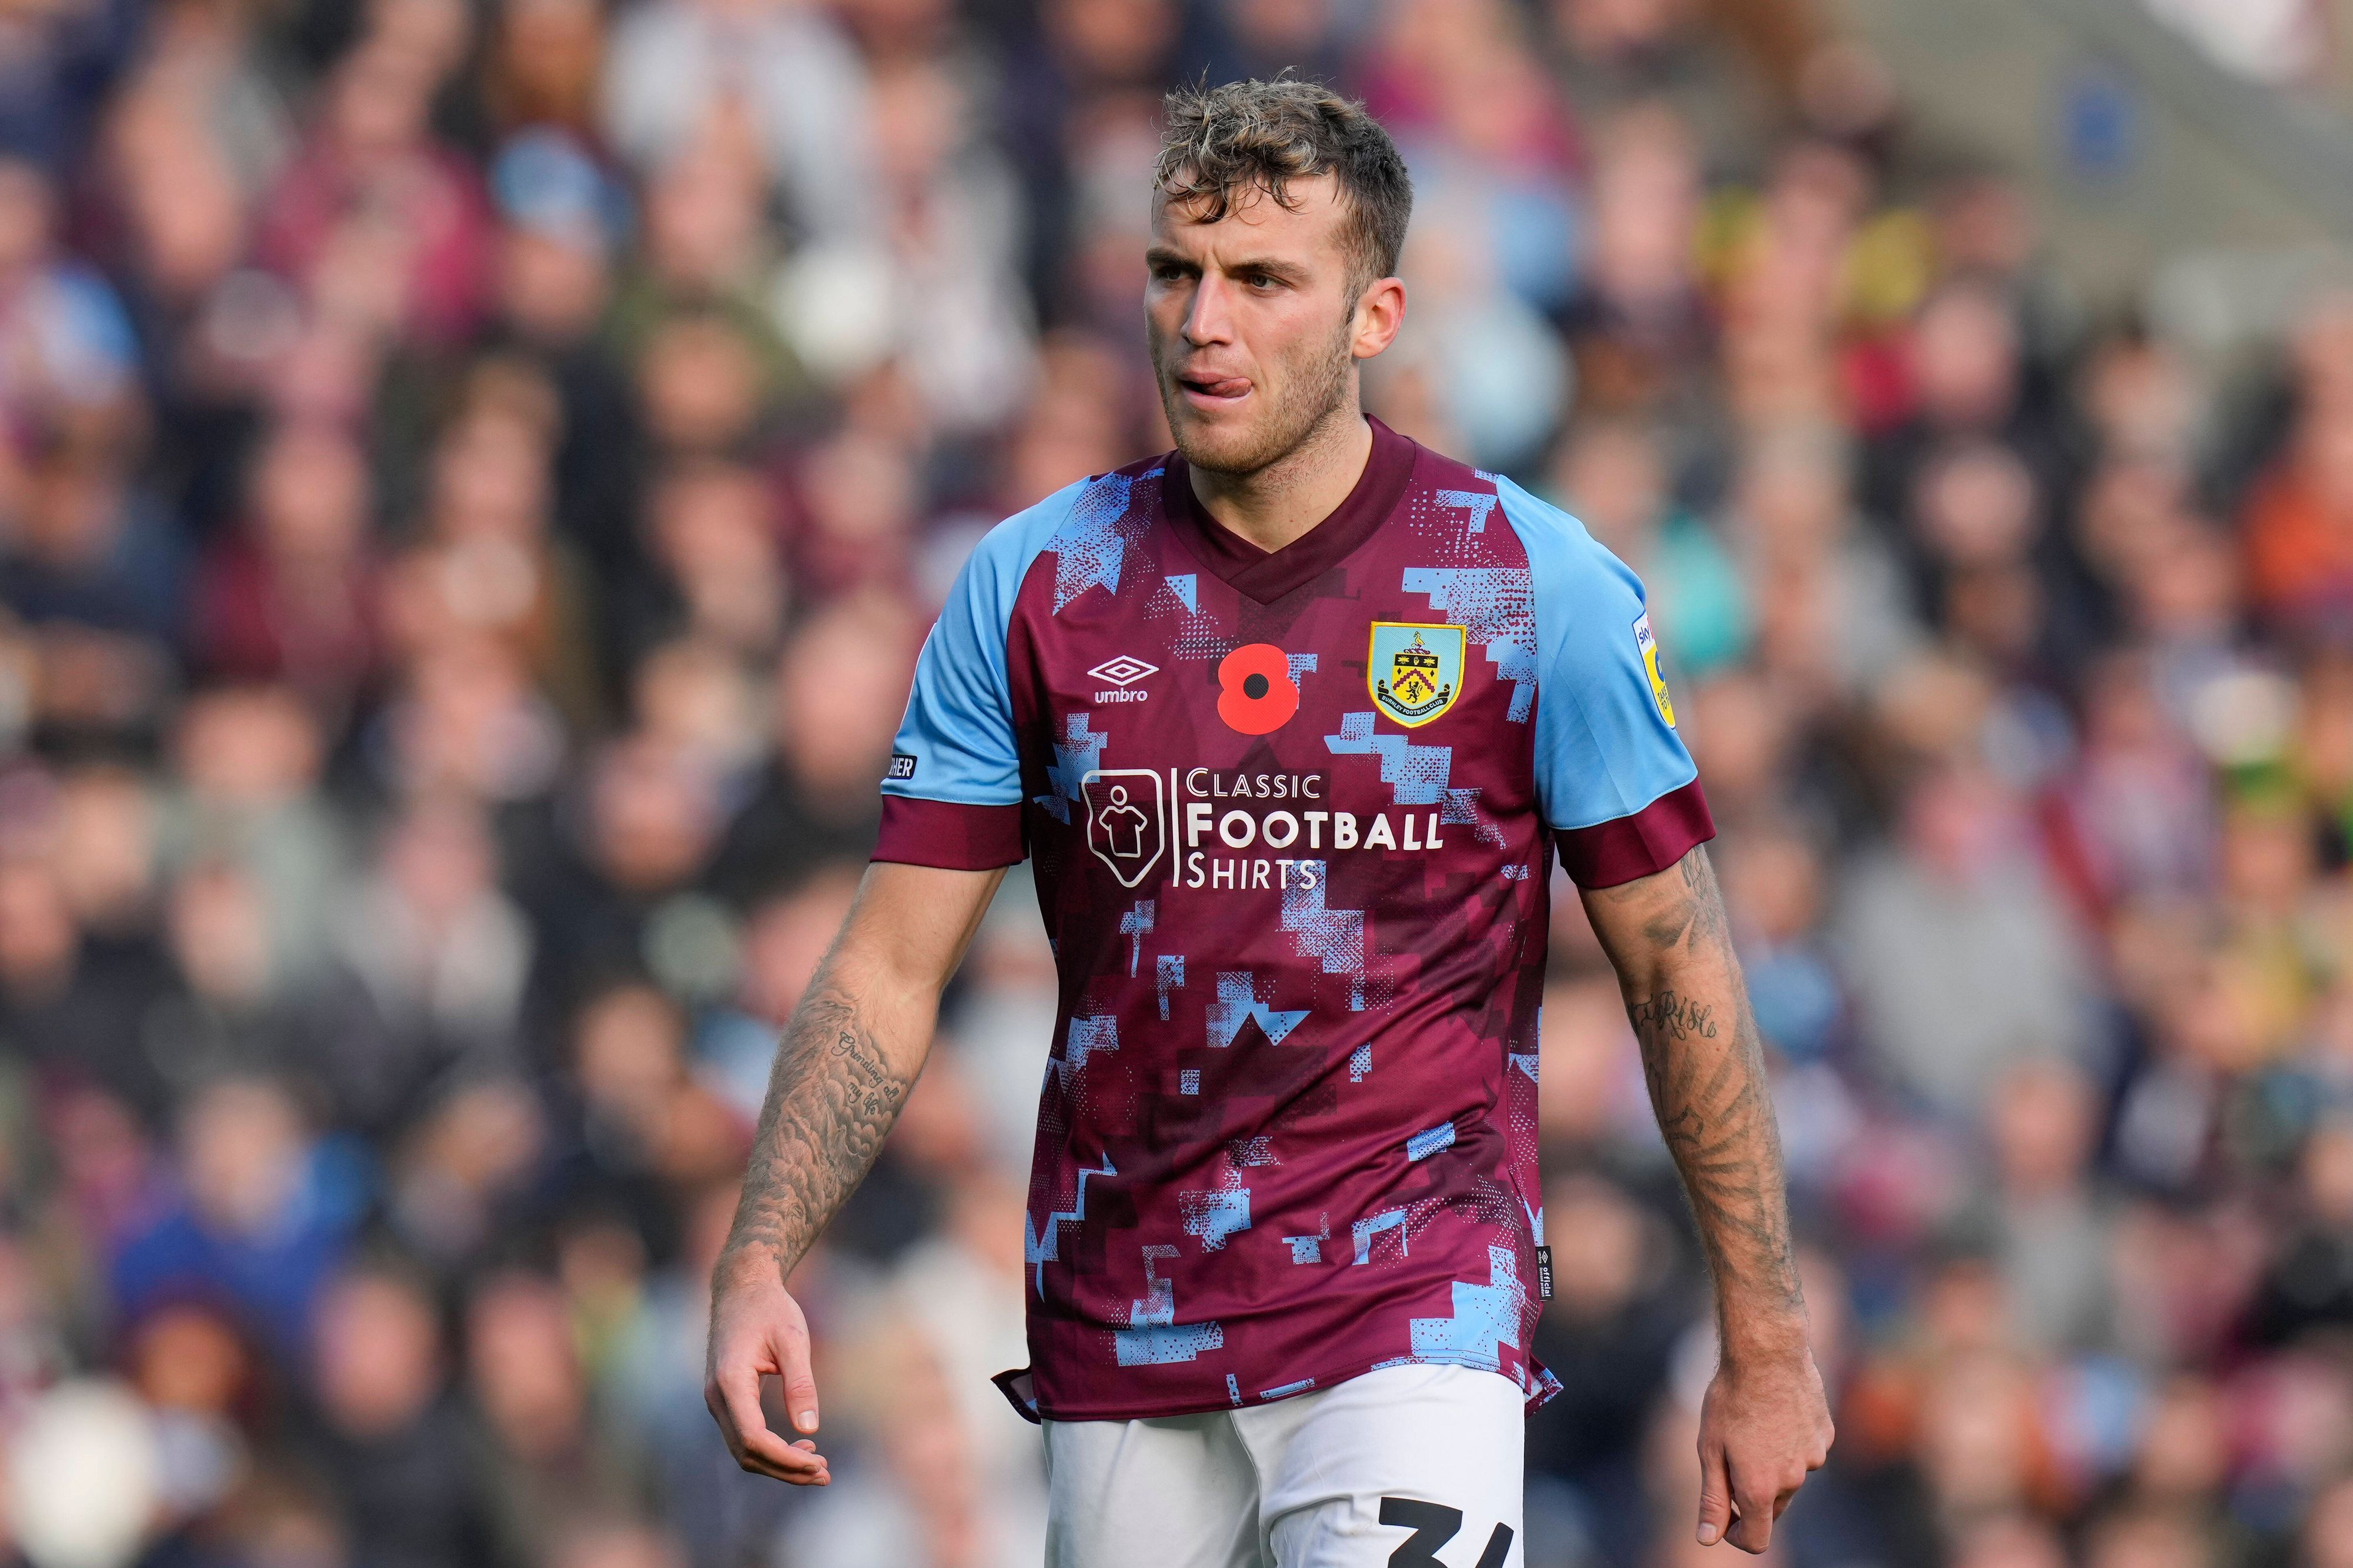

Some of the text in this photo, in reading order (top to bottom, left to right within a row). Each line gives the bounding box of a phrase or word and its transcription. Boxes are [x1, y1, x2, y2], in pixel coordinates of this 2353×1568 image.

[1095, 687, 1148, 703] umbro
[1381, 695, 1444, 716] BURNLEY FOOTBALL CLUB
[1187, 802, 1444, 850] FOOTBALL
[848, 1082, 863, 1104] my
[1543, 1267, 1551, 1296] official
